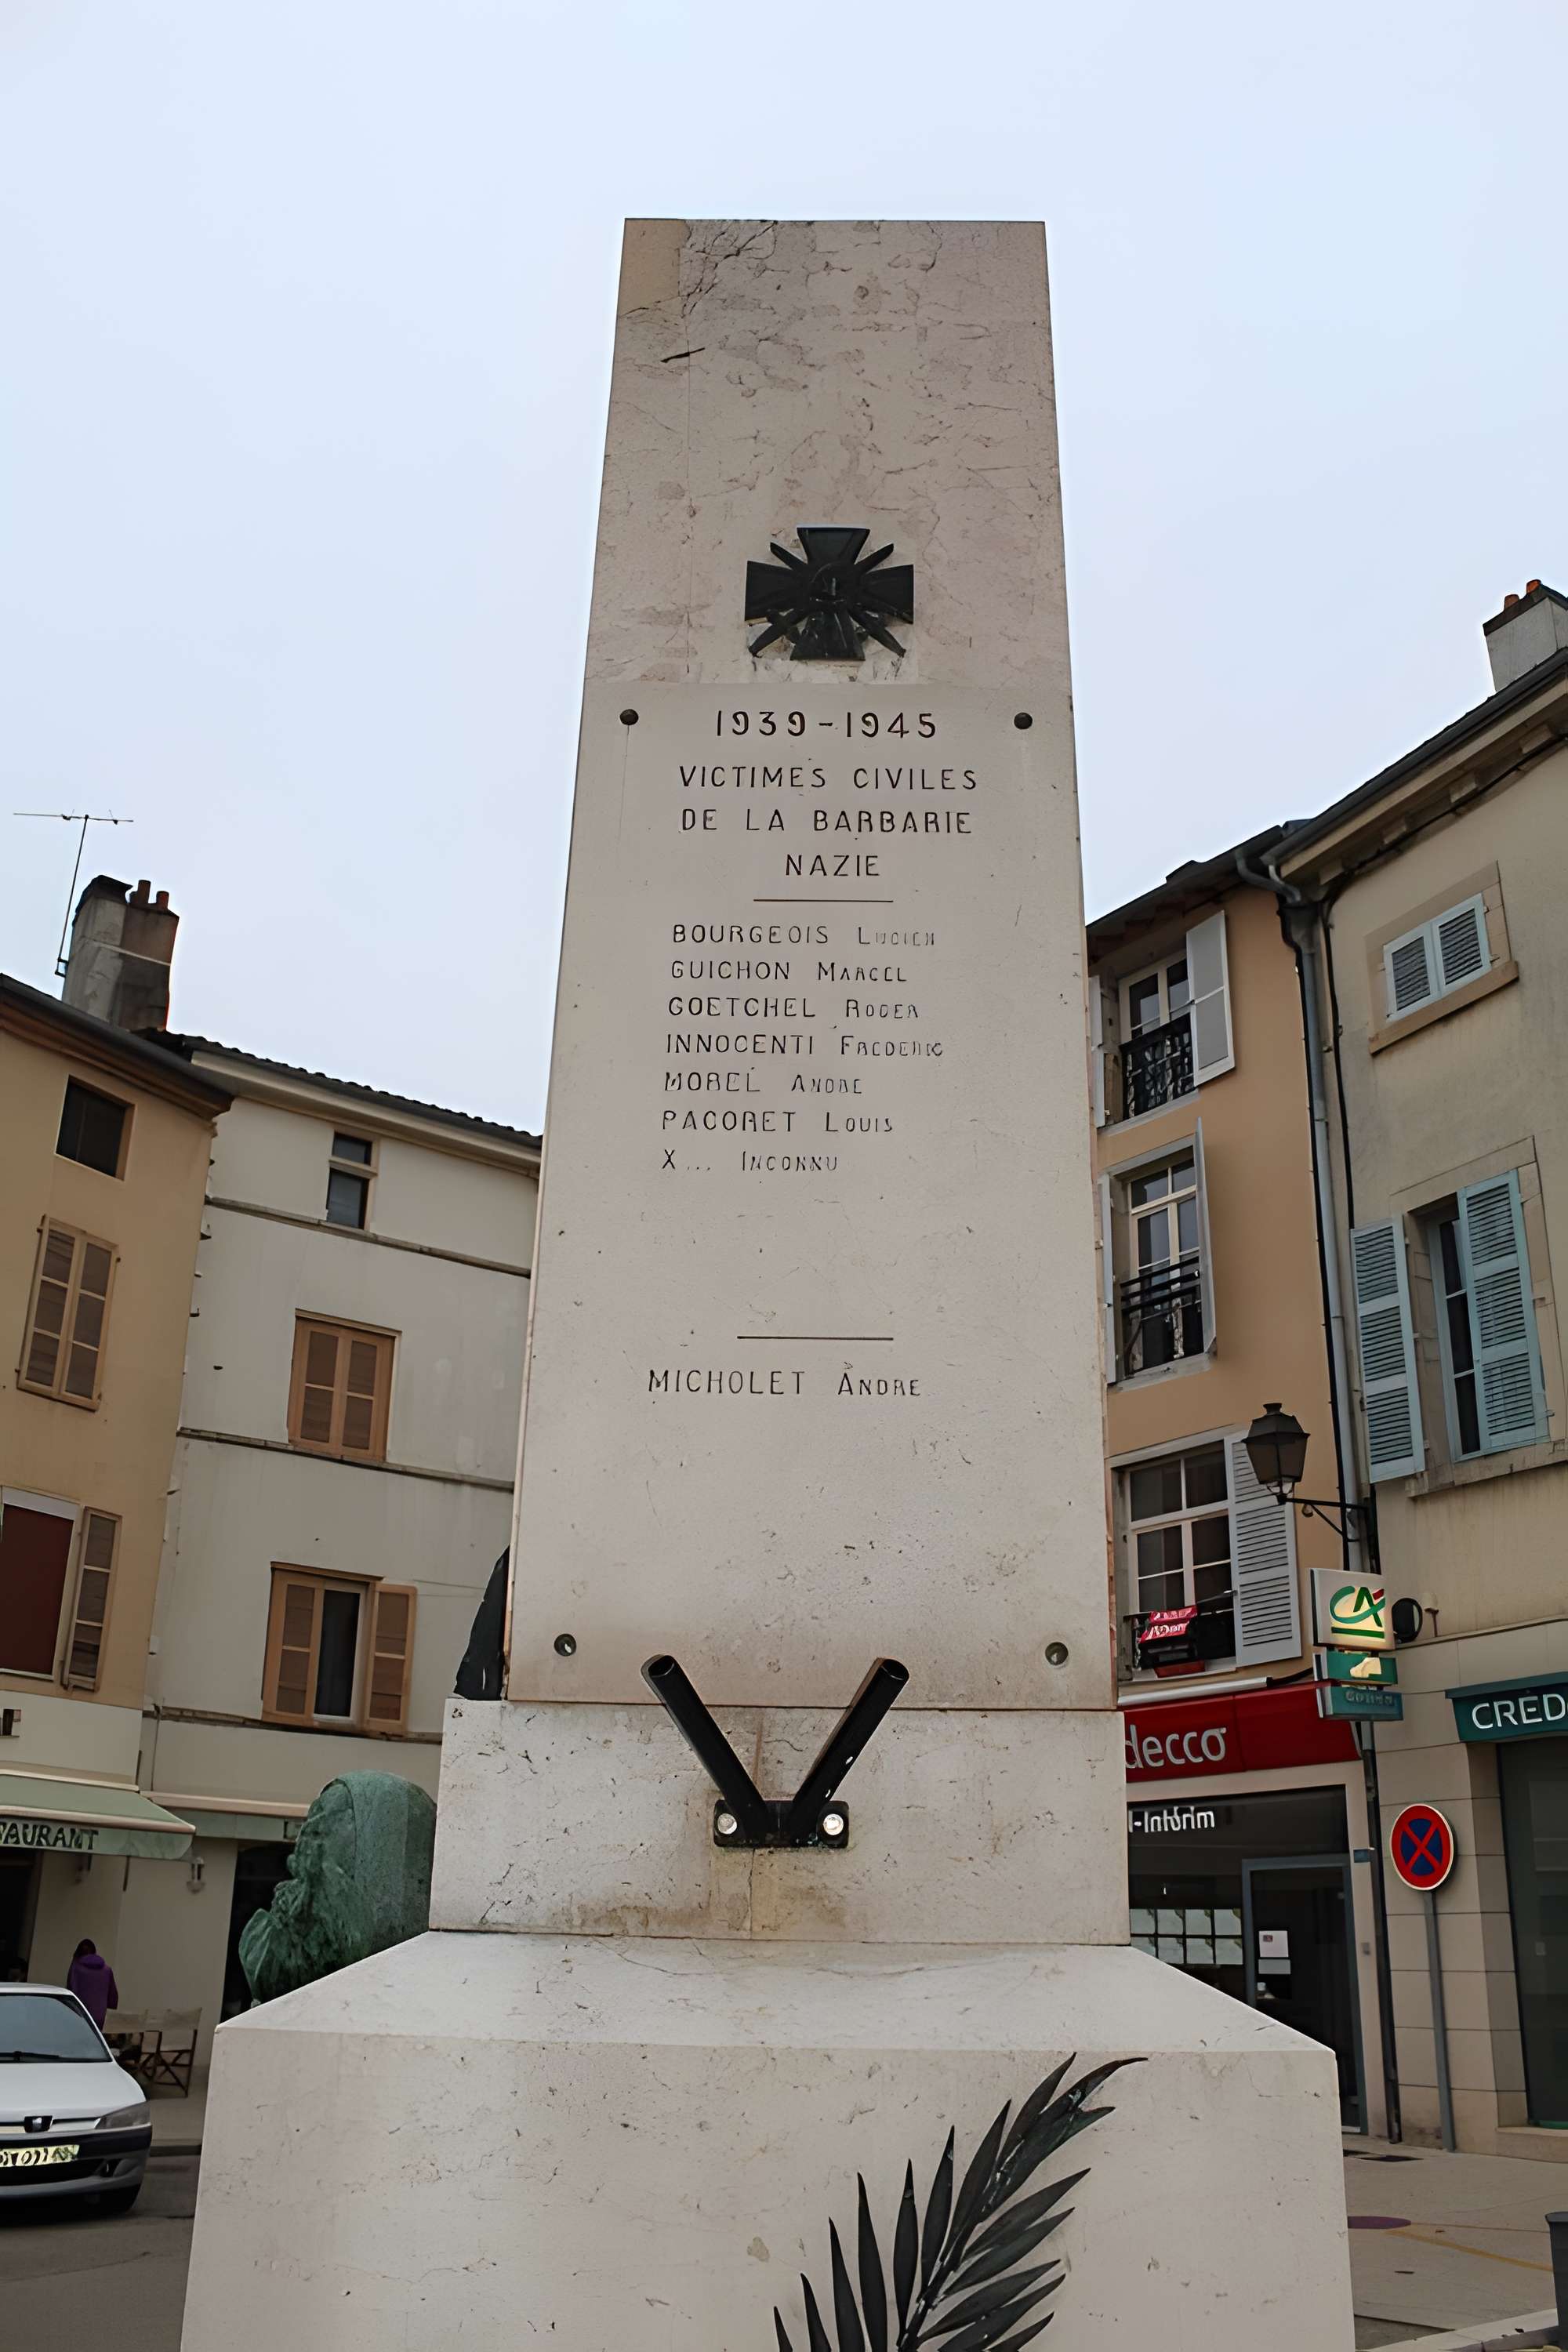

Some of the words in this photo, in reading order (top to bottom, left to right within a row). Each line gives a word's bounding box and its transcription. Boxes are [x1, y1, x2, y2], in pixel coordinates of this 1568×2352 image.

[717, 710, 936, 739] 1939-1945
[679, 764, 826, 789] VICTIMES
[853, 767, 977, 790] CIVILES
[681, 808, 717, 831] DE
[746, 808, 785, 832] LA
[813, 809, 972, 834] BARBARIE
[785, 853, 880, 877] NAZIE
[673, 924, 829, 945] BOURGEOIS
[671, 960, 789, 981] GUICHON
[818, 961, 908, 982] MARCEL
[668, 996, 816, 1018] GOETCHEL
[666, 1033, 813, 1055] INNOCENTI
[664, 1071, 761, 1093] MOREL
[662, 1109, 797, 1133] PACORET
[825, 1111, 893, 1133] LOUIS
[742, 1150, 837, 1172] INCONNU
[648, 1369, 805, 1396] MICHOLET
[1472, 1693, 1568, 1730] CRED
